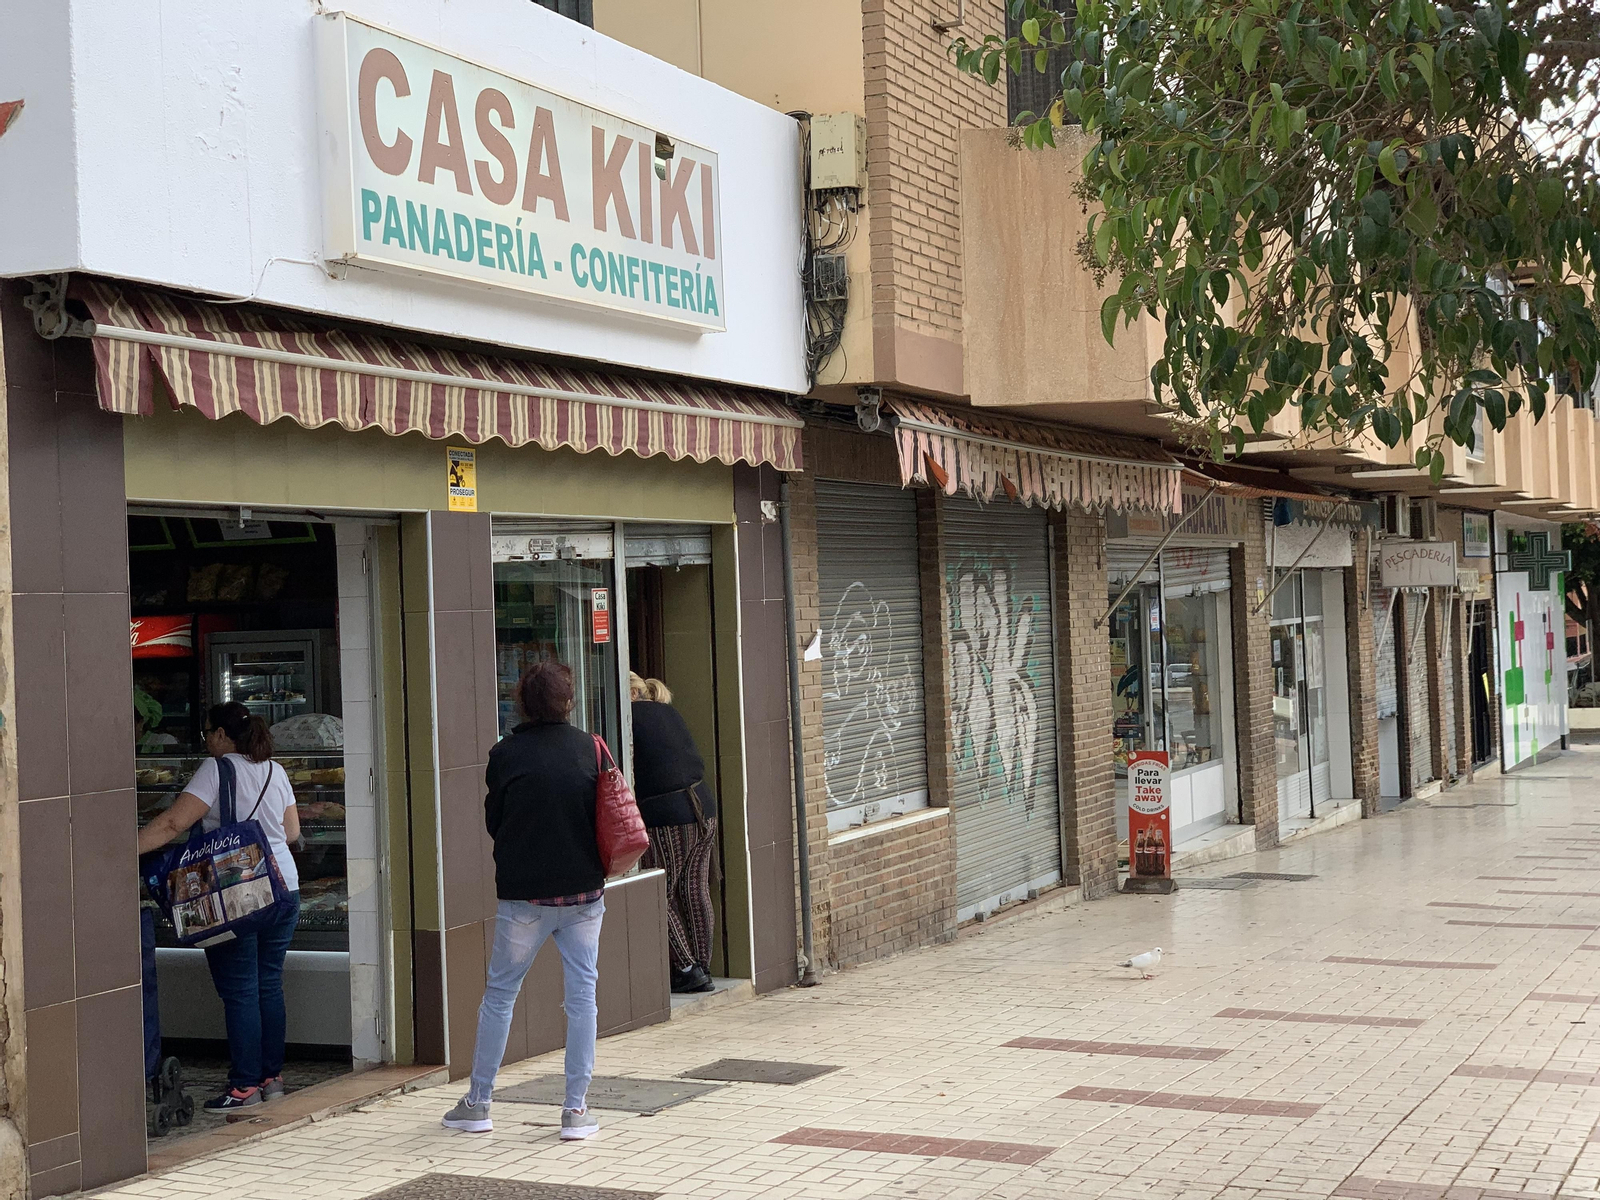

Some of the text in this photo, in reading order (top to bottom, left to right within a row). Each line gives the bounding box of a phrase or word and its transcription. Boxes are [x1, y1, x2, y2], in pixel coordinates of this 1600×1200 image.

[358, 47, 716, 260] CASA KIKI
[361, 187, 548, 280] PANADERÍA
[570, 242, 720, 317] CONFITERÍA
[450, 488, 475, 496] PROSEGUR
[1207, 496, 1229, 535] ALTA
[1384, 548, 1452, 569] PESCADERIA
[594, 592, 606, 600] Casa
[596, 602, 606, 610] Kiki
[1137, 768, 1159, 777] Para
[1135, 777, 1162, 785] llevar
[1136, 786, 1161, 794] Take
[1134, 795, 1163, 803] away
[1132, 803, 1165, 813] COLD DRINKS
